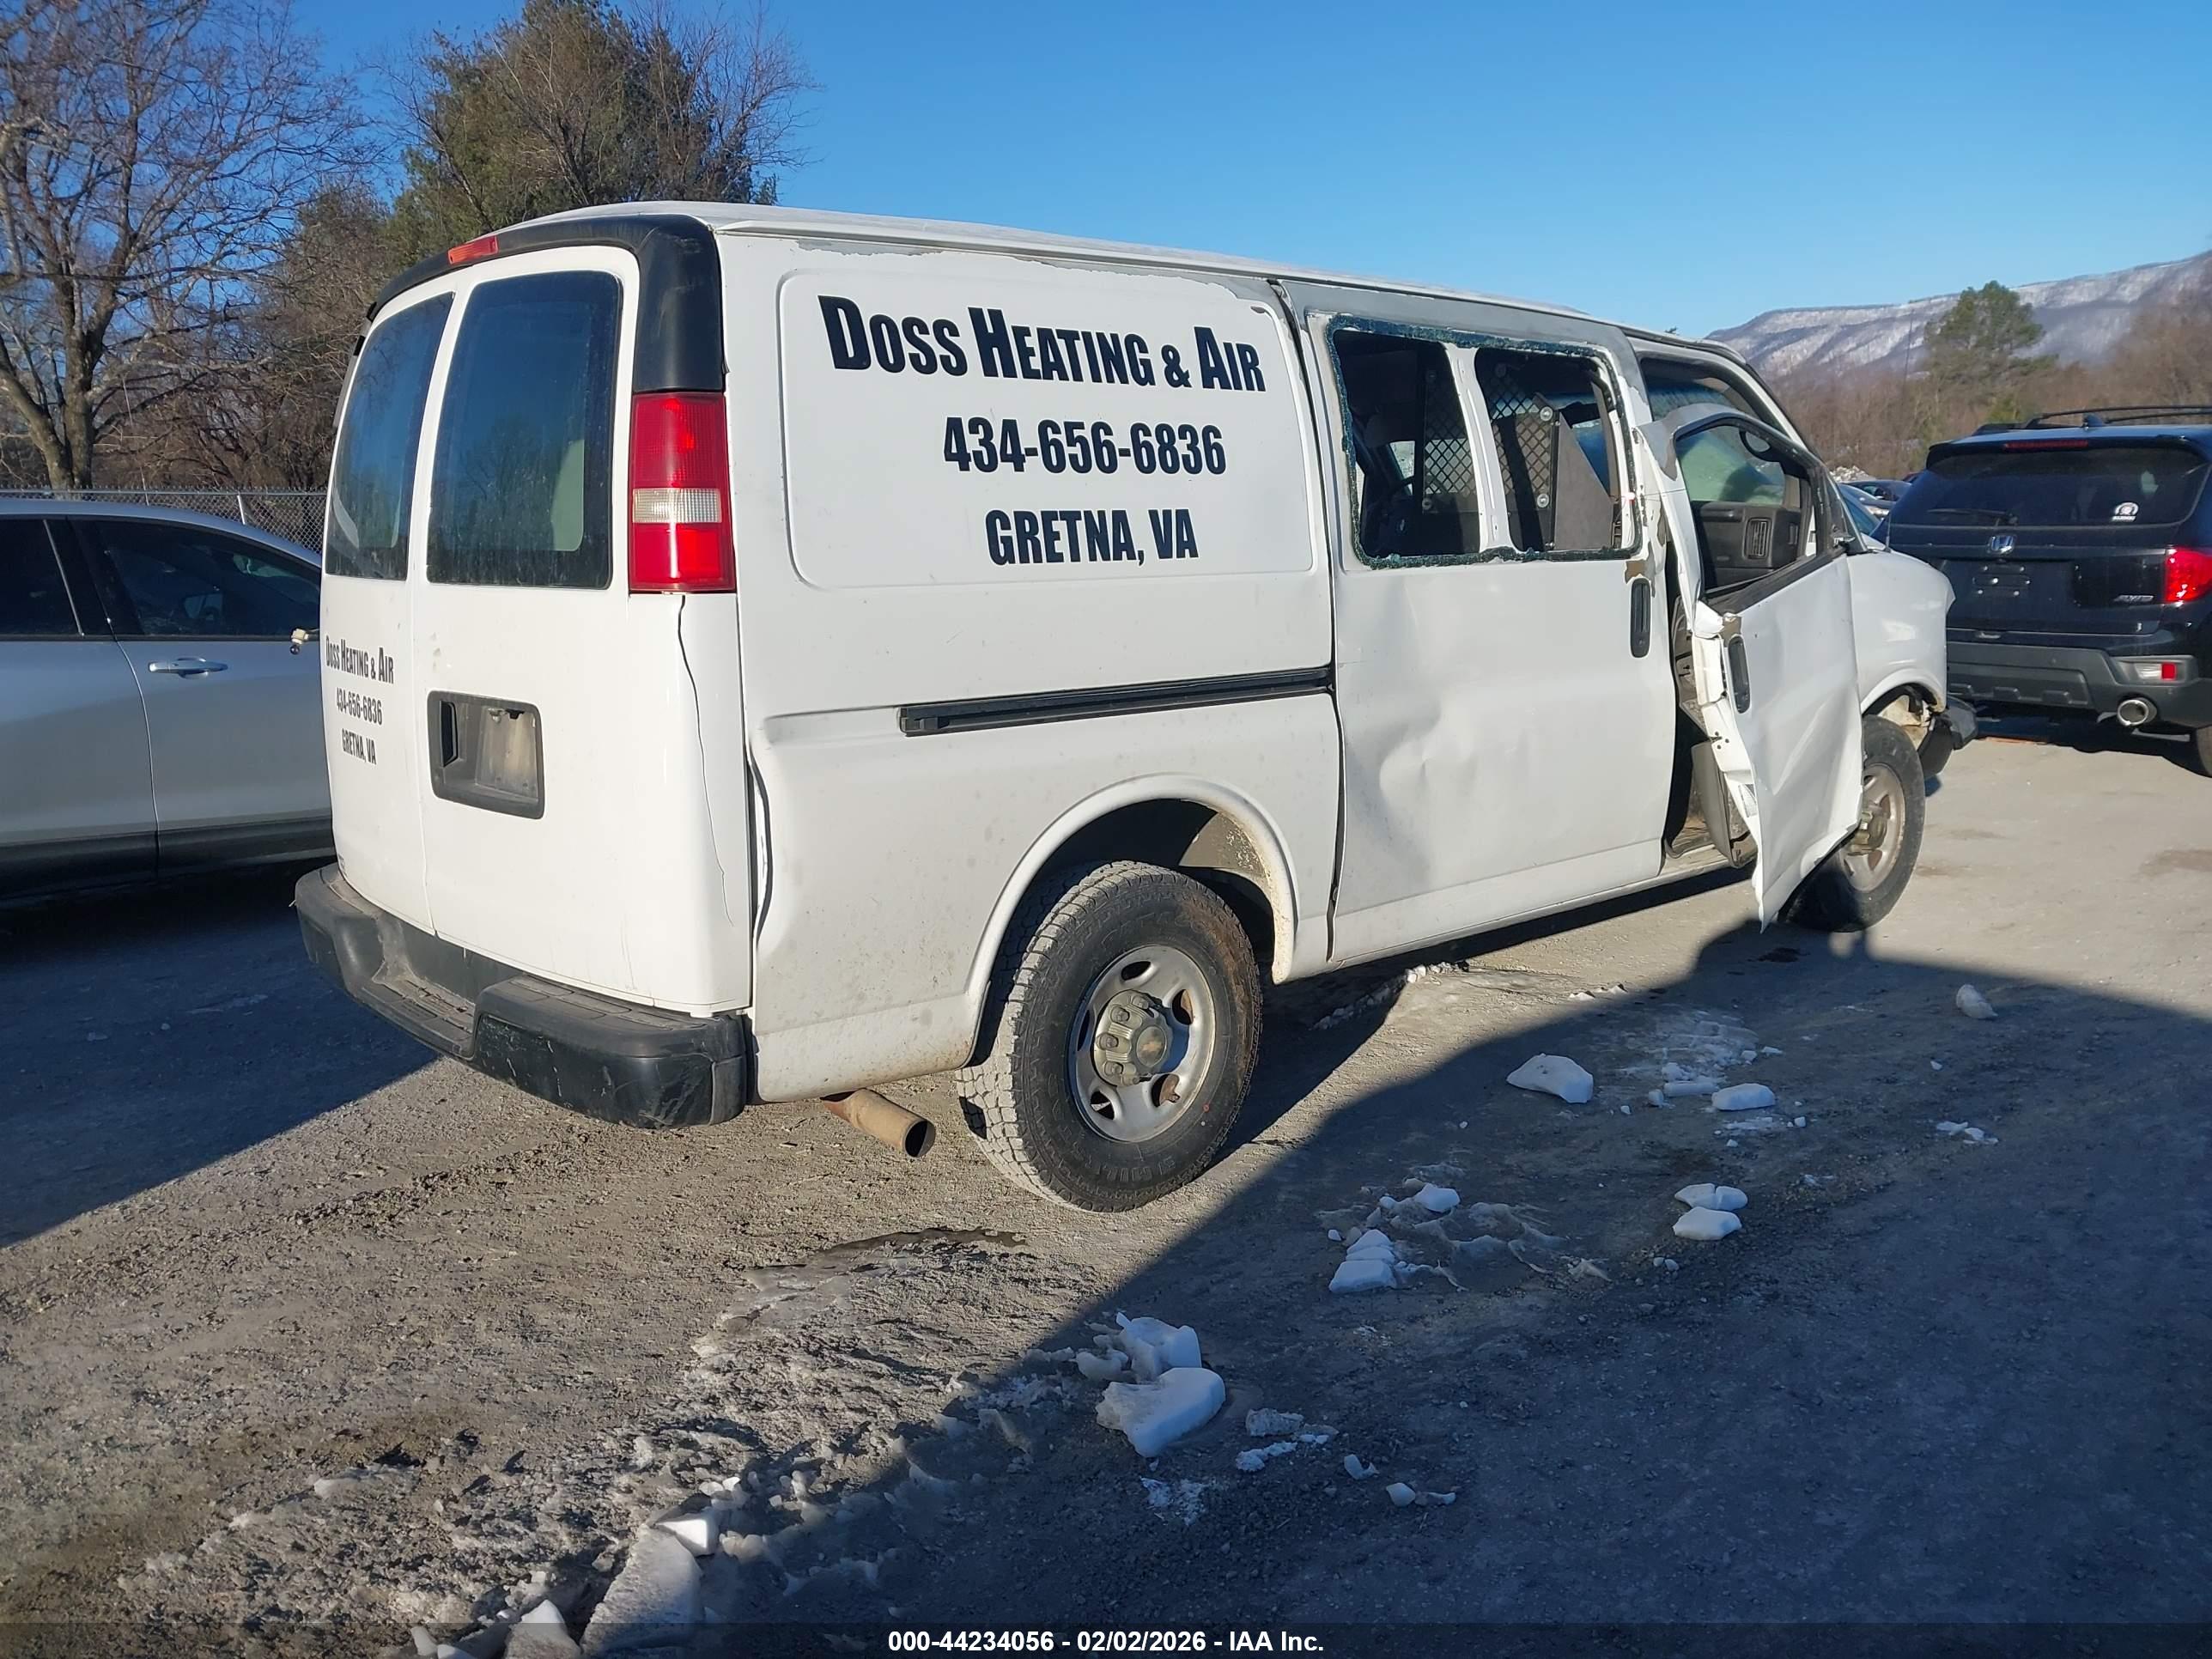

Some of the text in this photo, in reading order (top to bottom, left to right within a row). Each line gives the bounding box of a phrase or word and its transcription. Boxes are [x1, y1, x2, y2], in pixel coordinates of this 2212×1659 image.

[818, 295, 1267, 392] DOSS HEATING & AIR
[944, 416, 1226, 475] 434-656-6836
[985, 508, 1199, 567] GRETNA, VA
[340, 638, 369, 679] HEATING
[370, 657, 376, 681] &
[378, 647, 394, 684] AIR
[336, 687, 383, 726] 434-656-6836
[342, 728, 377, 766] GRETNA, VA
